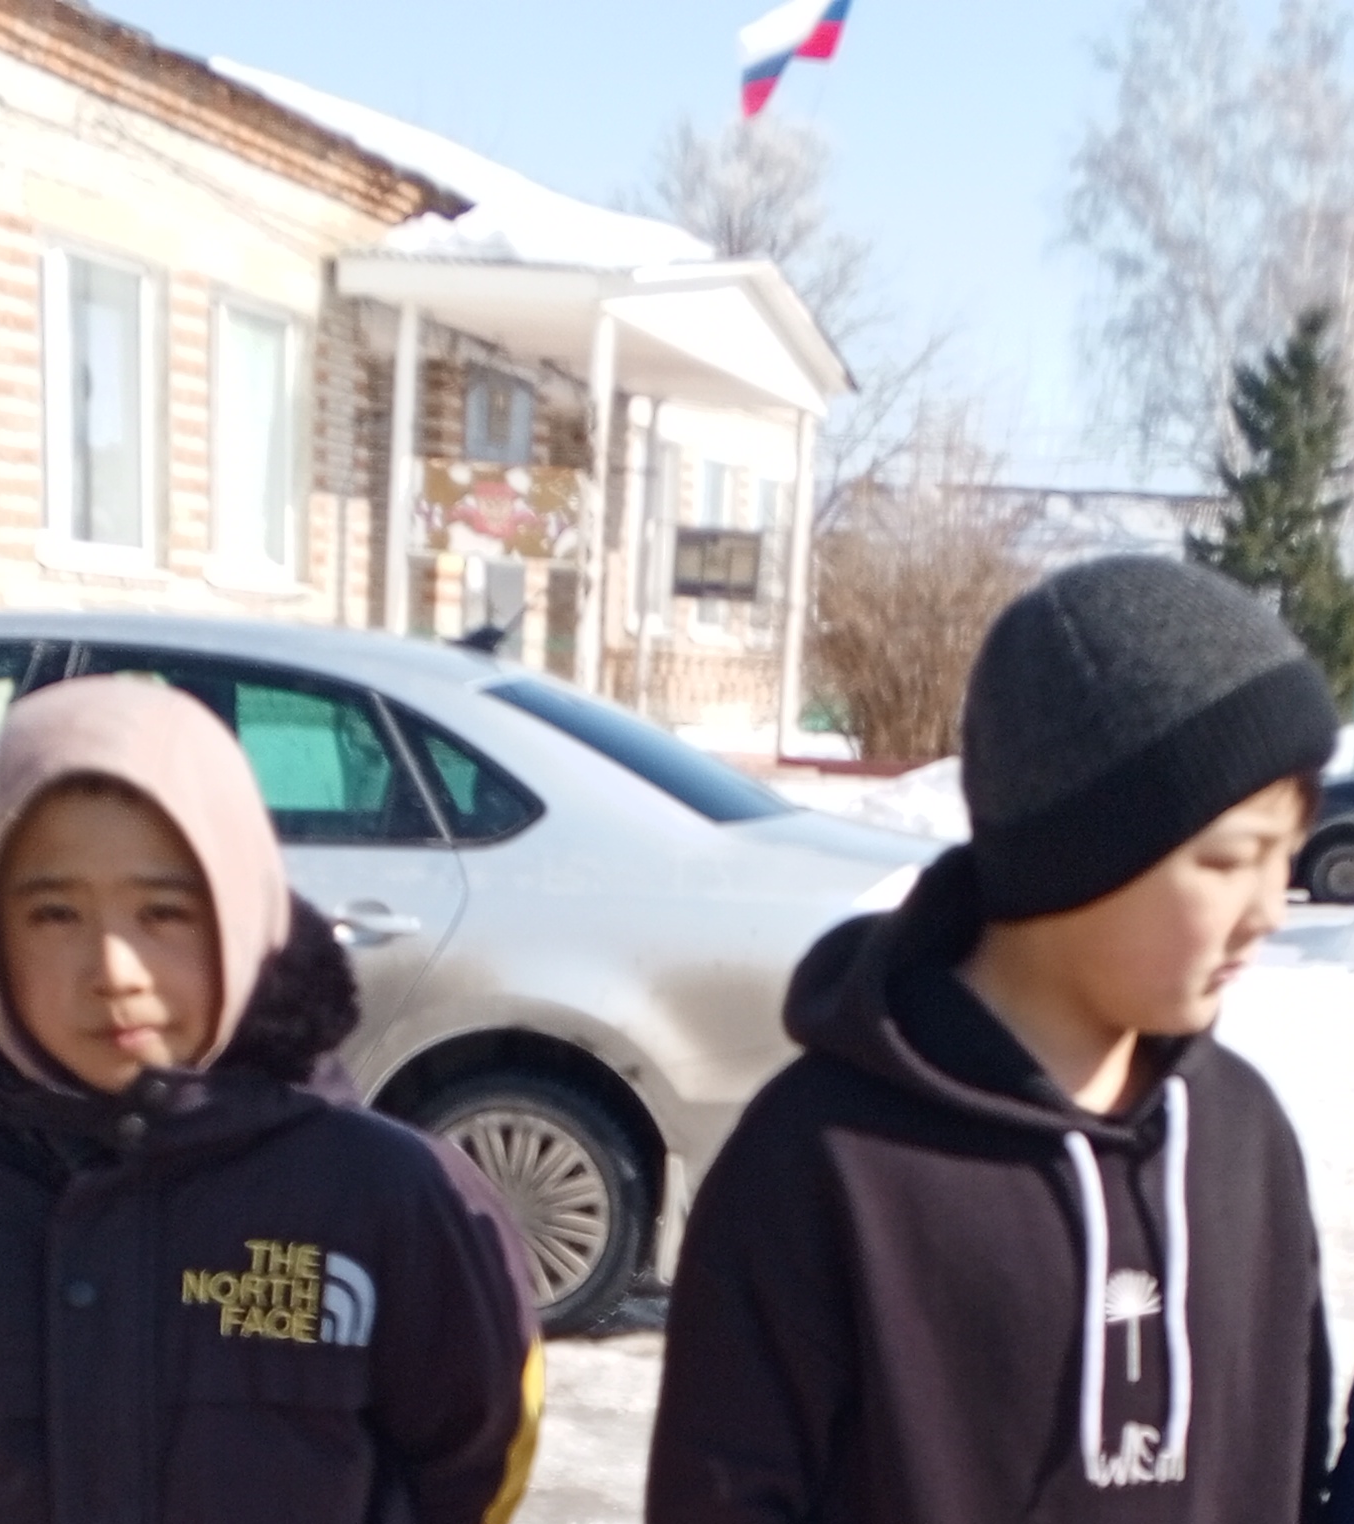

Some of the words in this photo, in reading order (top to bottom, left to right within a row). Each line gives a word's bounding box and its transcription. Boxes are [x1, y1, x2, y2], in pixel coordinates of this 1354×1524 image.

[244, 1239, 322, 1279] THE
[182, 1269, 322, 1315] NORTH
[220, 1304, 319, 1344] FACE
